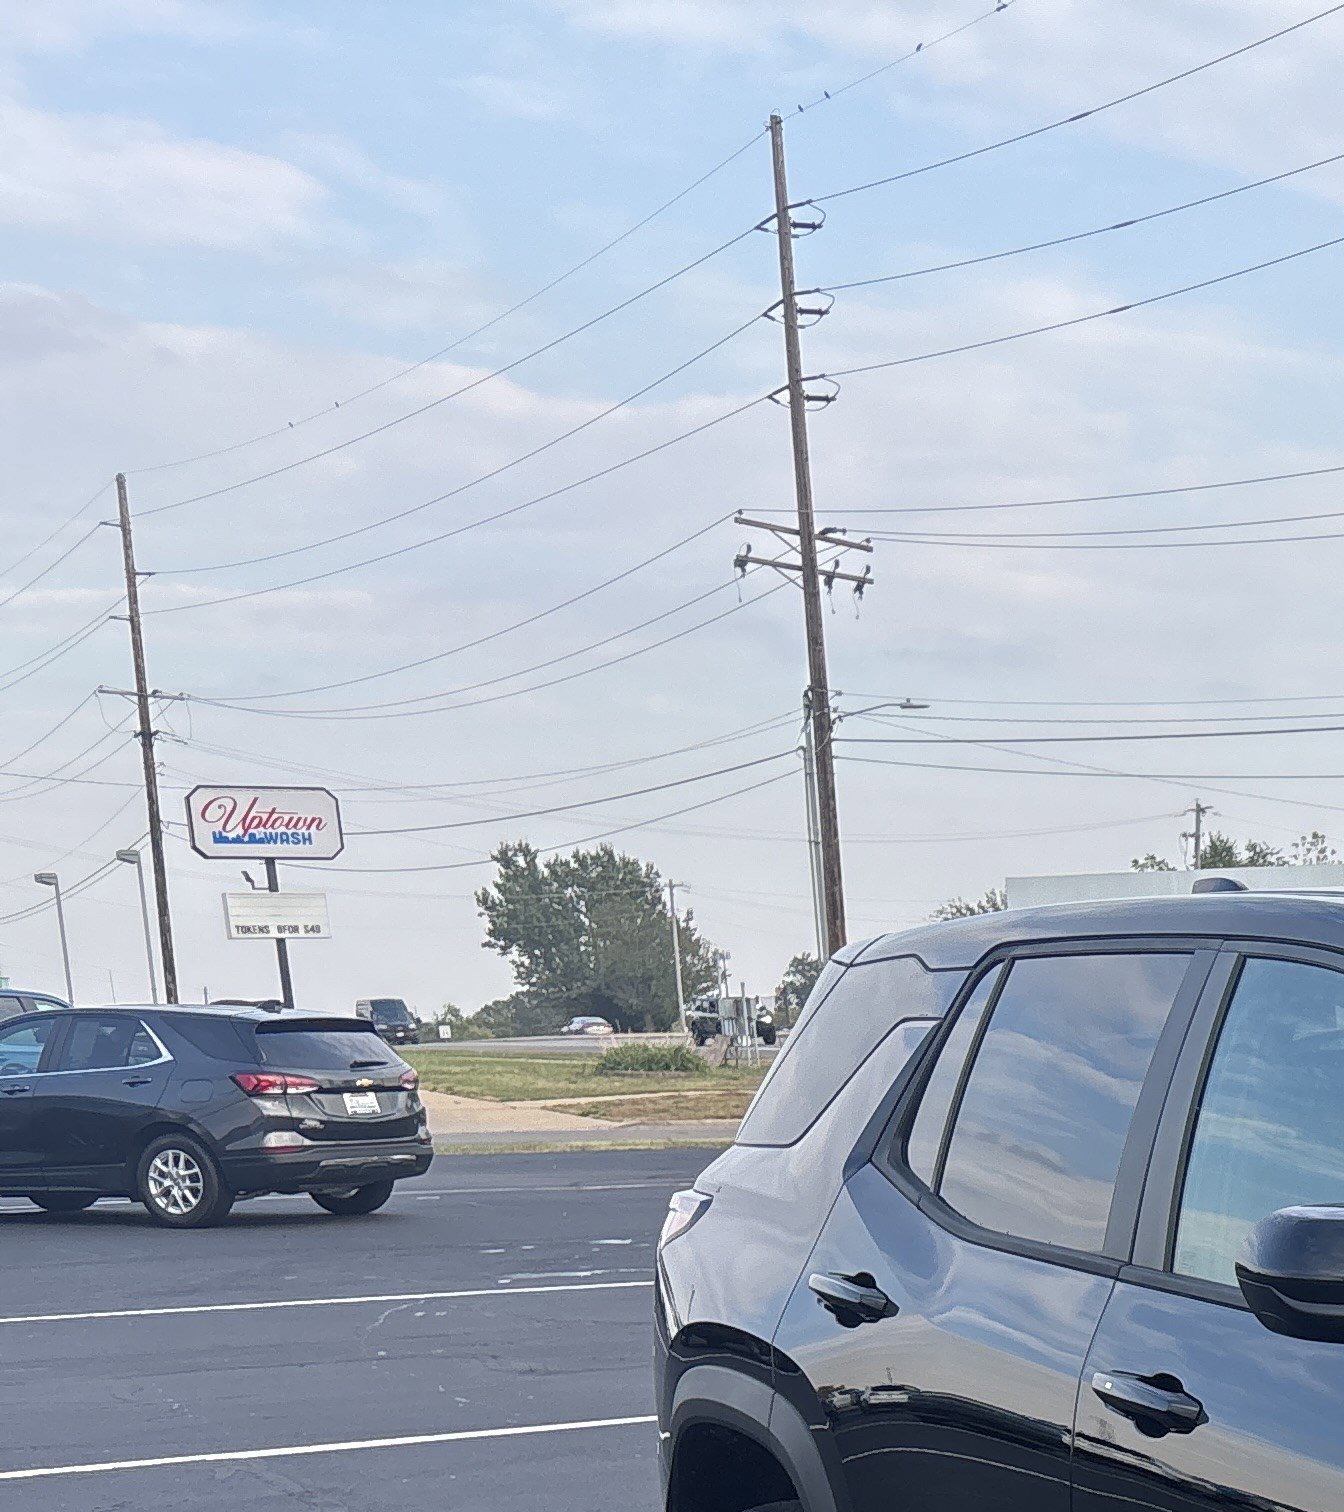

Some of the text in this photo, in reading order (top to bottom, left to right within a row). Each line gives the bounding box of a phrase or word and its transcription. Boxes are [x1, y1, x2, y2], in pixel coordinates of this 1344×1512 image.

[200, 796, 328, 837] Uptown
[264, 831, 313, 845] WASH
[235, 925, 270, 934] TOKENS
